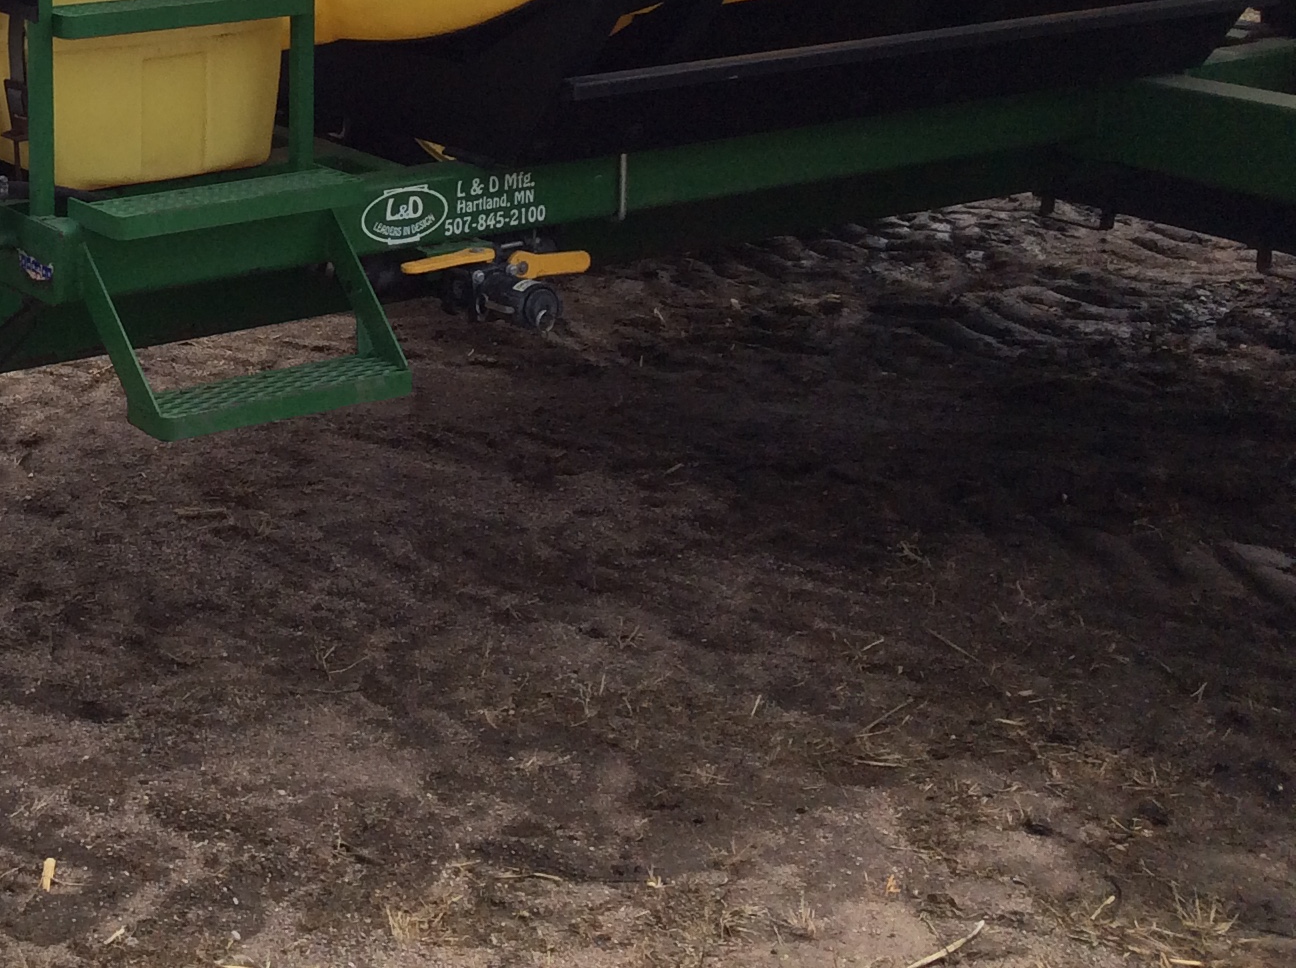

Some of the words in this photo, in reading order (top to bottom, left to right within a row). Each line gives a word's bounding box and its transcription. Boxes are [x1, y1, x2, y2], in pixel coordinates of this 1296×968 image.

[456, 180, 466, 198] L
[470, 177, 484, 196] &
[489, 175, 499, 193] D
[504, 171, 535, 191] Mfg.
[514, 189, 535, 205] MN
[386, 195, 423, 221] L&D
[444, 205, 546, 236] 507-845-2100
